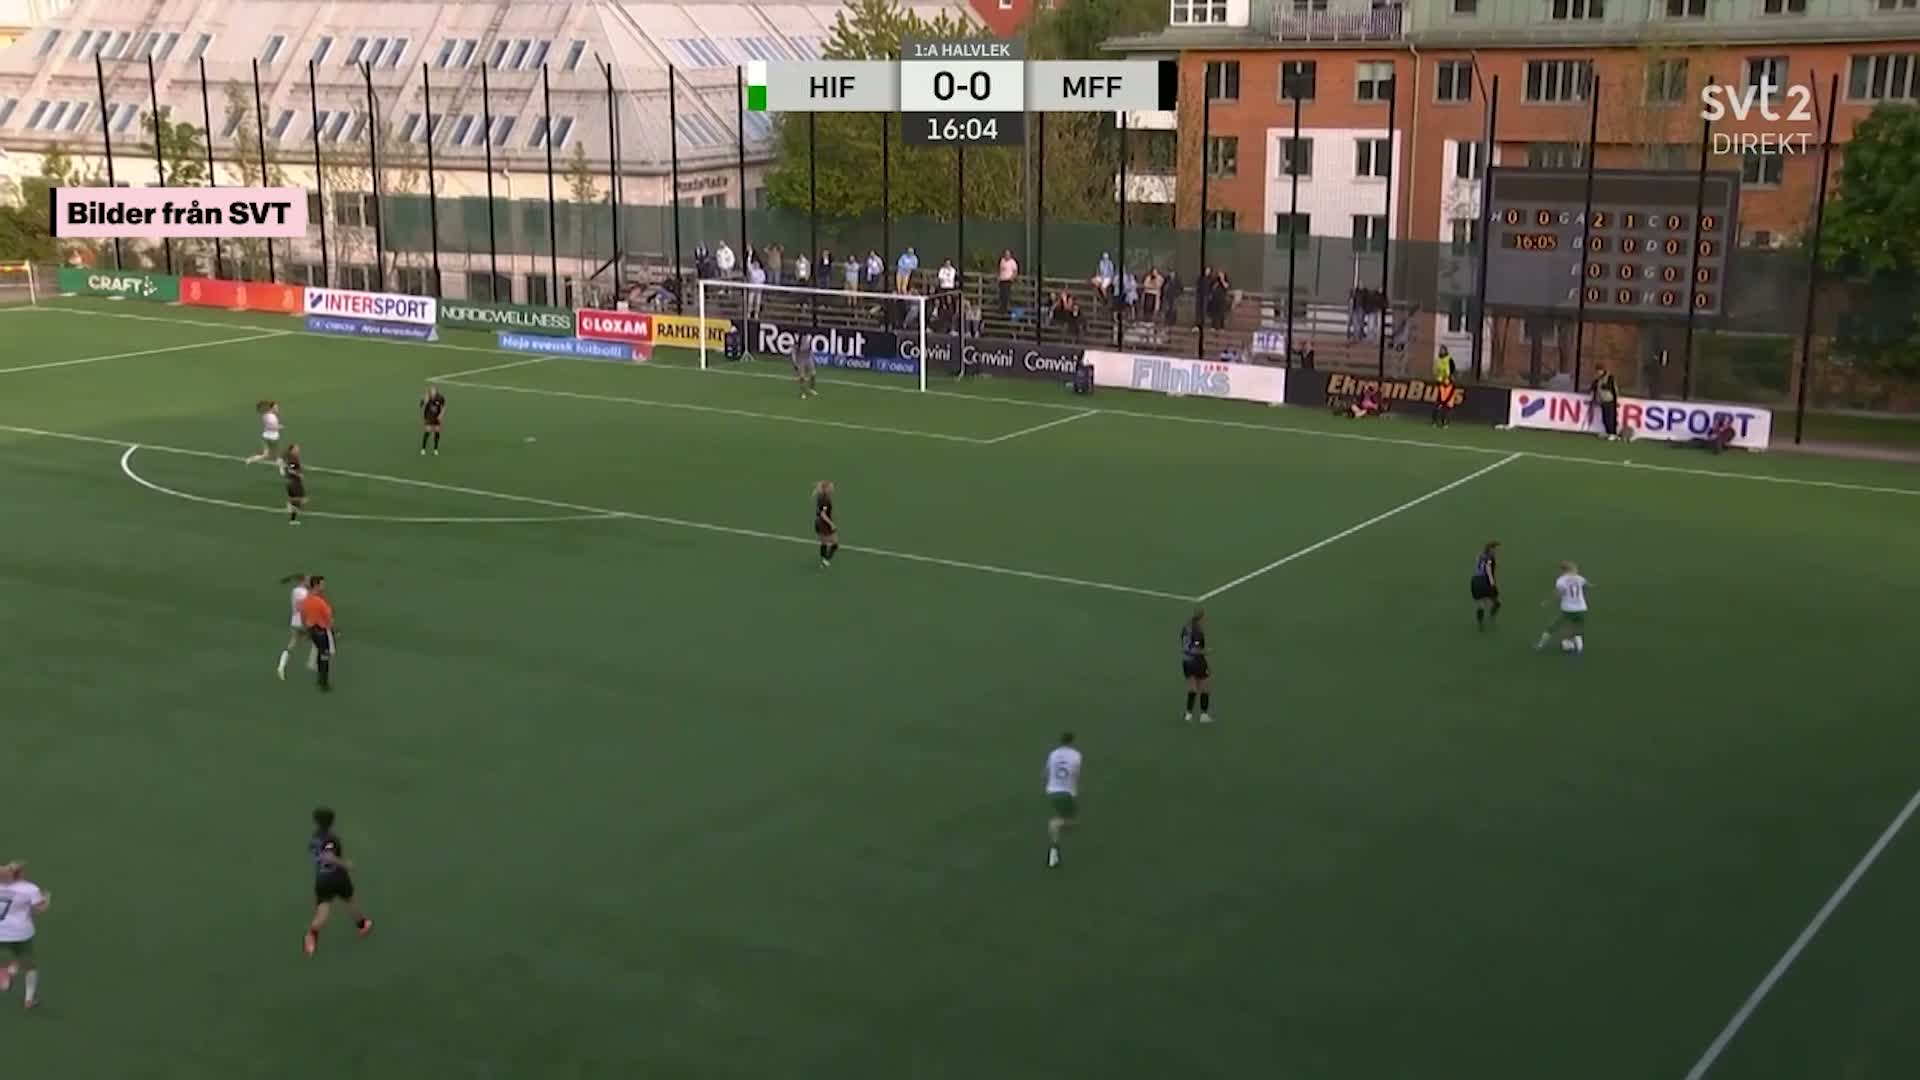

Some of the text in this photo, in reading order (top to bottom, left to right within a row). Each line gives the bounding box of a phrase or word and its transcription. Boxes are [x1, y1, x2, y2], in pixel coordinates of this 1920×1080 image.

[1506, 209, 1518, 225] 0
[1539, 210, 1550, 225] 0
[1593, 212, 1604, 228] 2
[1626, 213, 1635, 228] 1
[1668, 215, 1680, 231] 0
[1702, 215, 1713, 231] 0
[1592, 237, 1602, 251] 0
[1624, 238, 1635, 253] 0
[1666, 240, 1678, 255] 0
[1700, 241, 1711, 256] 0
[1590, 264, 1600, 278] 0
[1621, 265, 1632, 280] 0
[1664, 266, 1675, 282] 0
[1697, 268, 1708, 283] 0
[87, 275, 142, 294] CRAFT
[325, 293, 429, 320] INTERSPORT
[1588, 287, 1598, 302] 0
[1619, 289, 1630, 304] 0
[1662, 291, 1674, 306] 0
[1695, 293, 1706, 308] 0
[594, 317, 648, 336] LOXAM
[657, 323, 724, 341] RAMIRNT
[532, 340, 574, 352] svensk
[900, 340, 950, 361] Covini
[1024, 351, 1078, 372] Convini
[1132, 358, 1230, 394] Flinks
